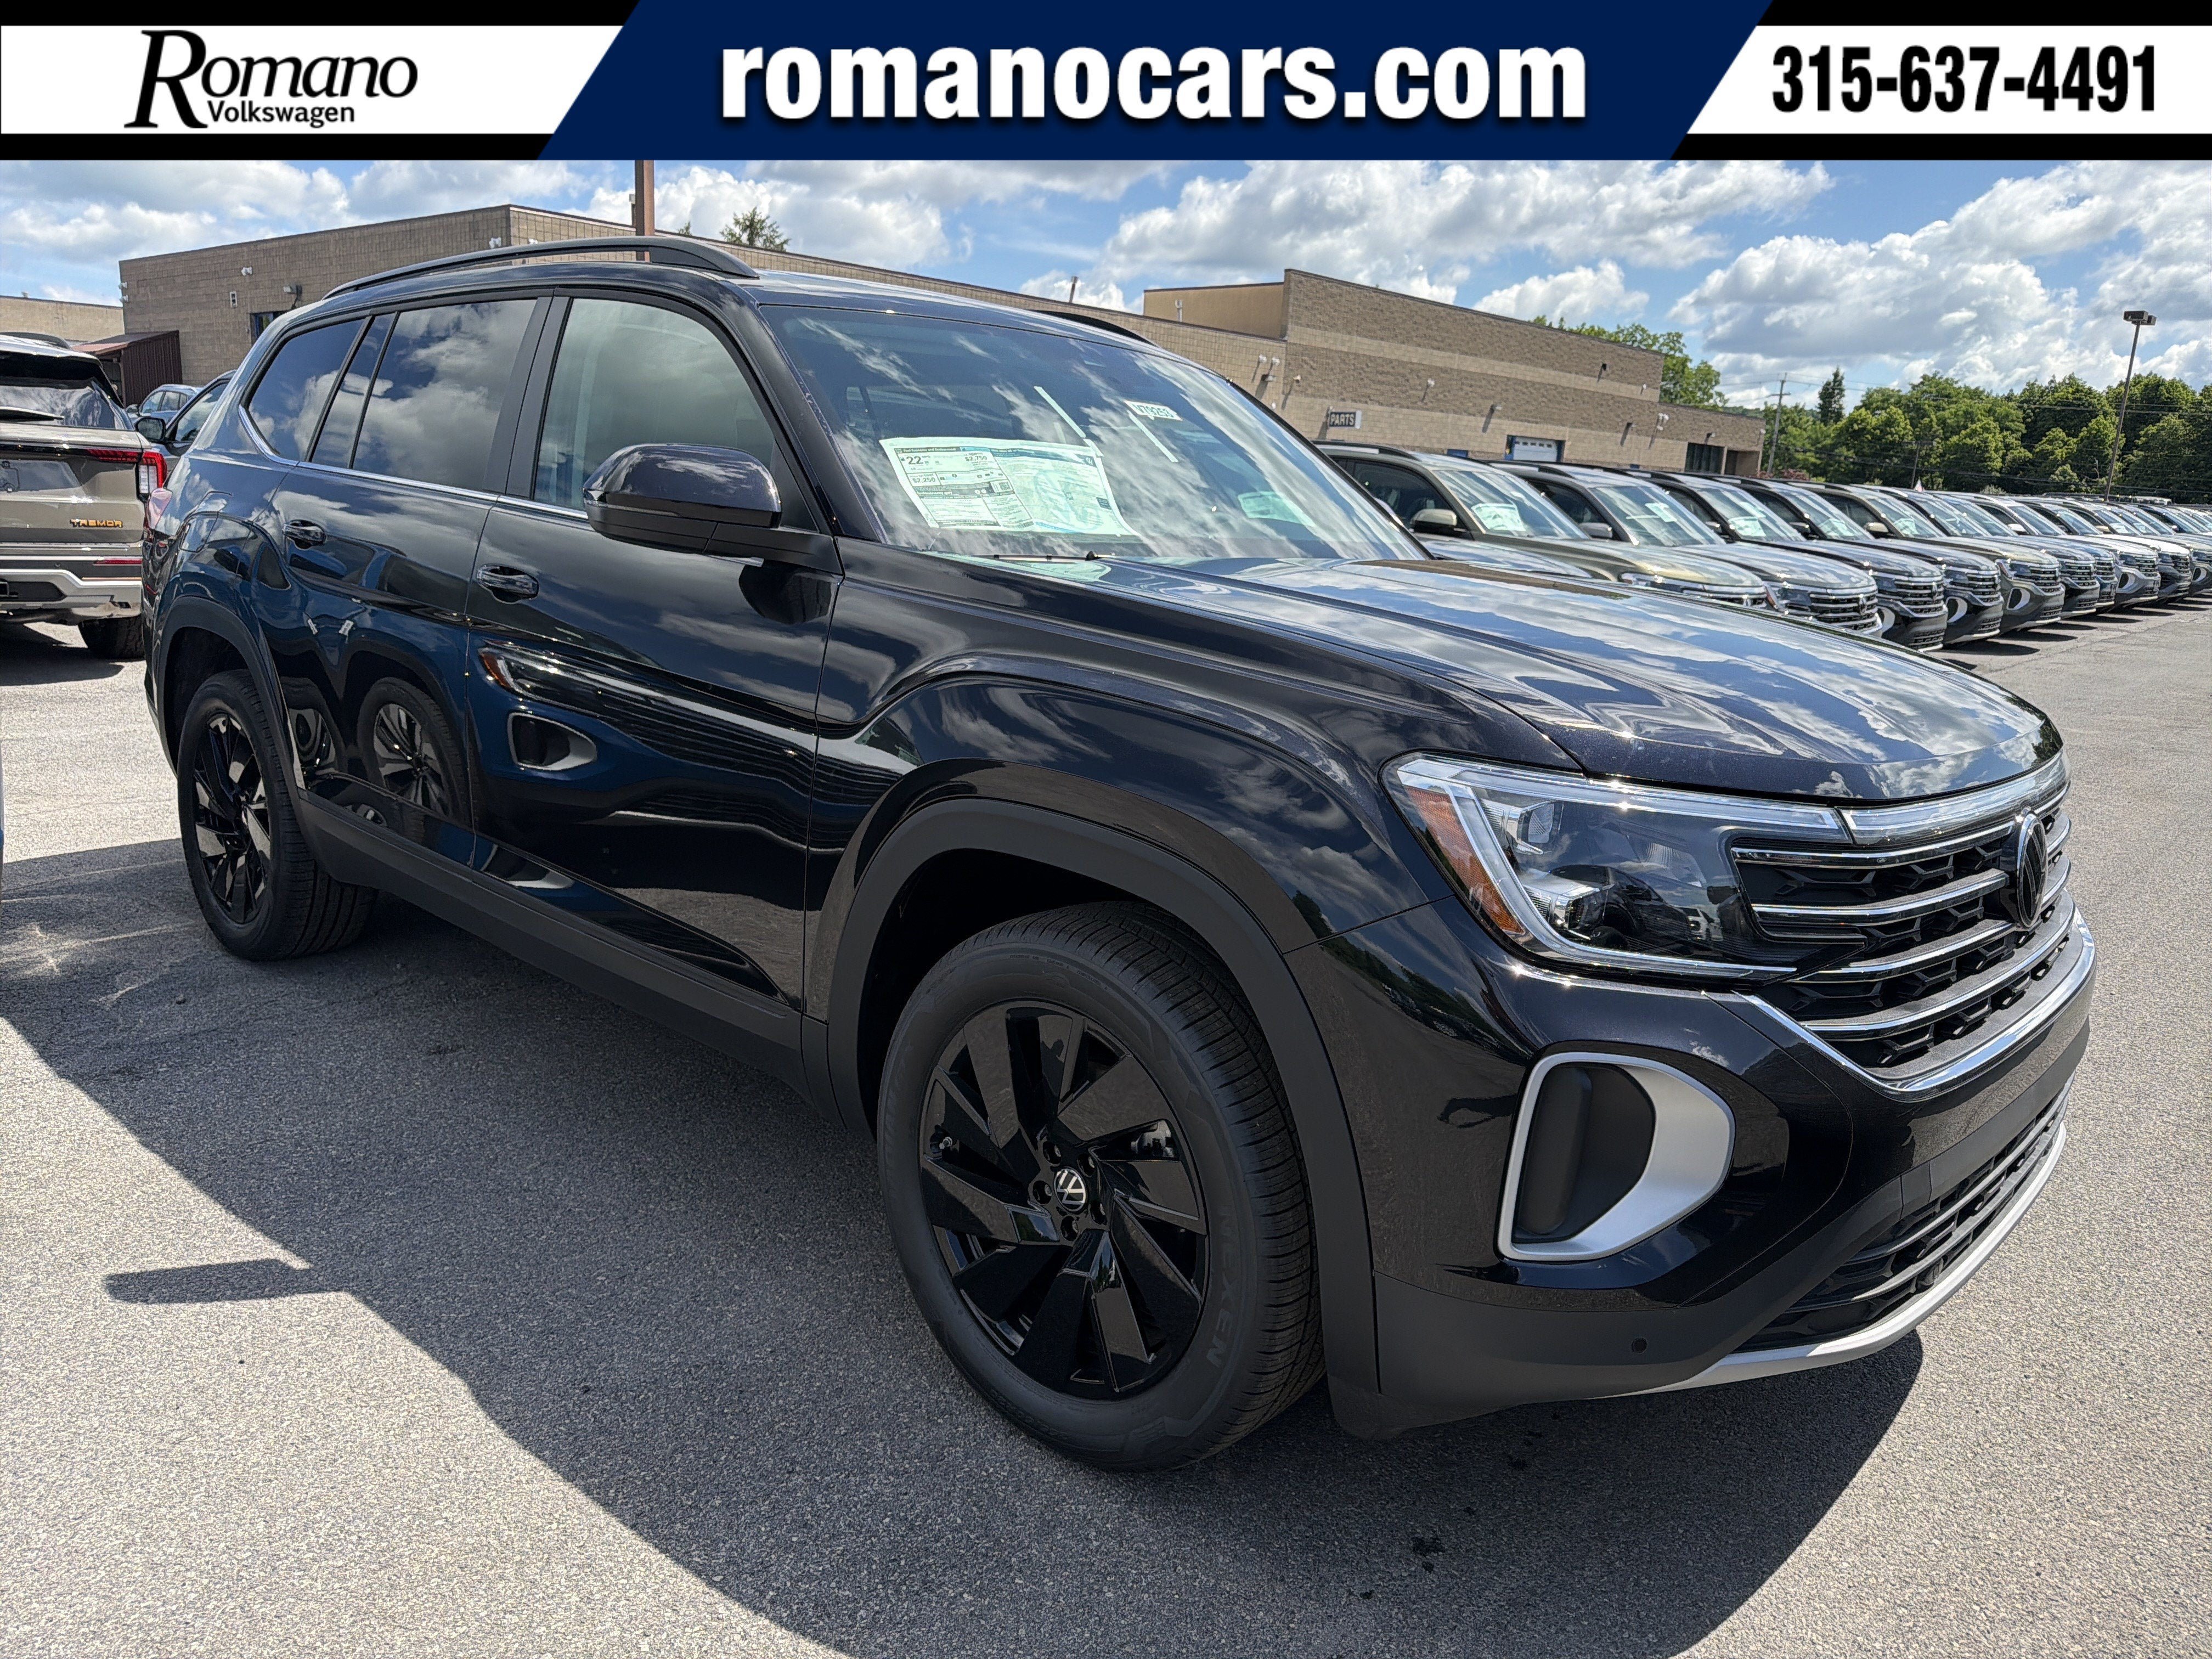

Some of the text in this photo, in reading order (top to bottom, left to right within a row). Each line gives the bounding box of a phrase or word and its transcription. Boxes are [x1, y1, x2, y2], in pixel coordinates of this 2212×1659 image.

[1330, 413, 1355, 426] PARTS
[907, 456, 923, 465] 22
[70, 518, 123, 528] TREMOR
[1206, 1204, 1237, 1369] NEXEN
